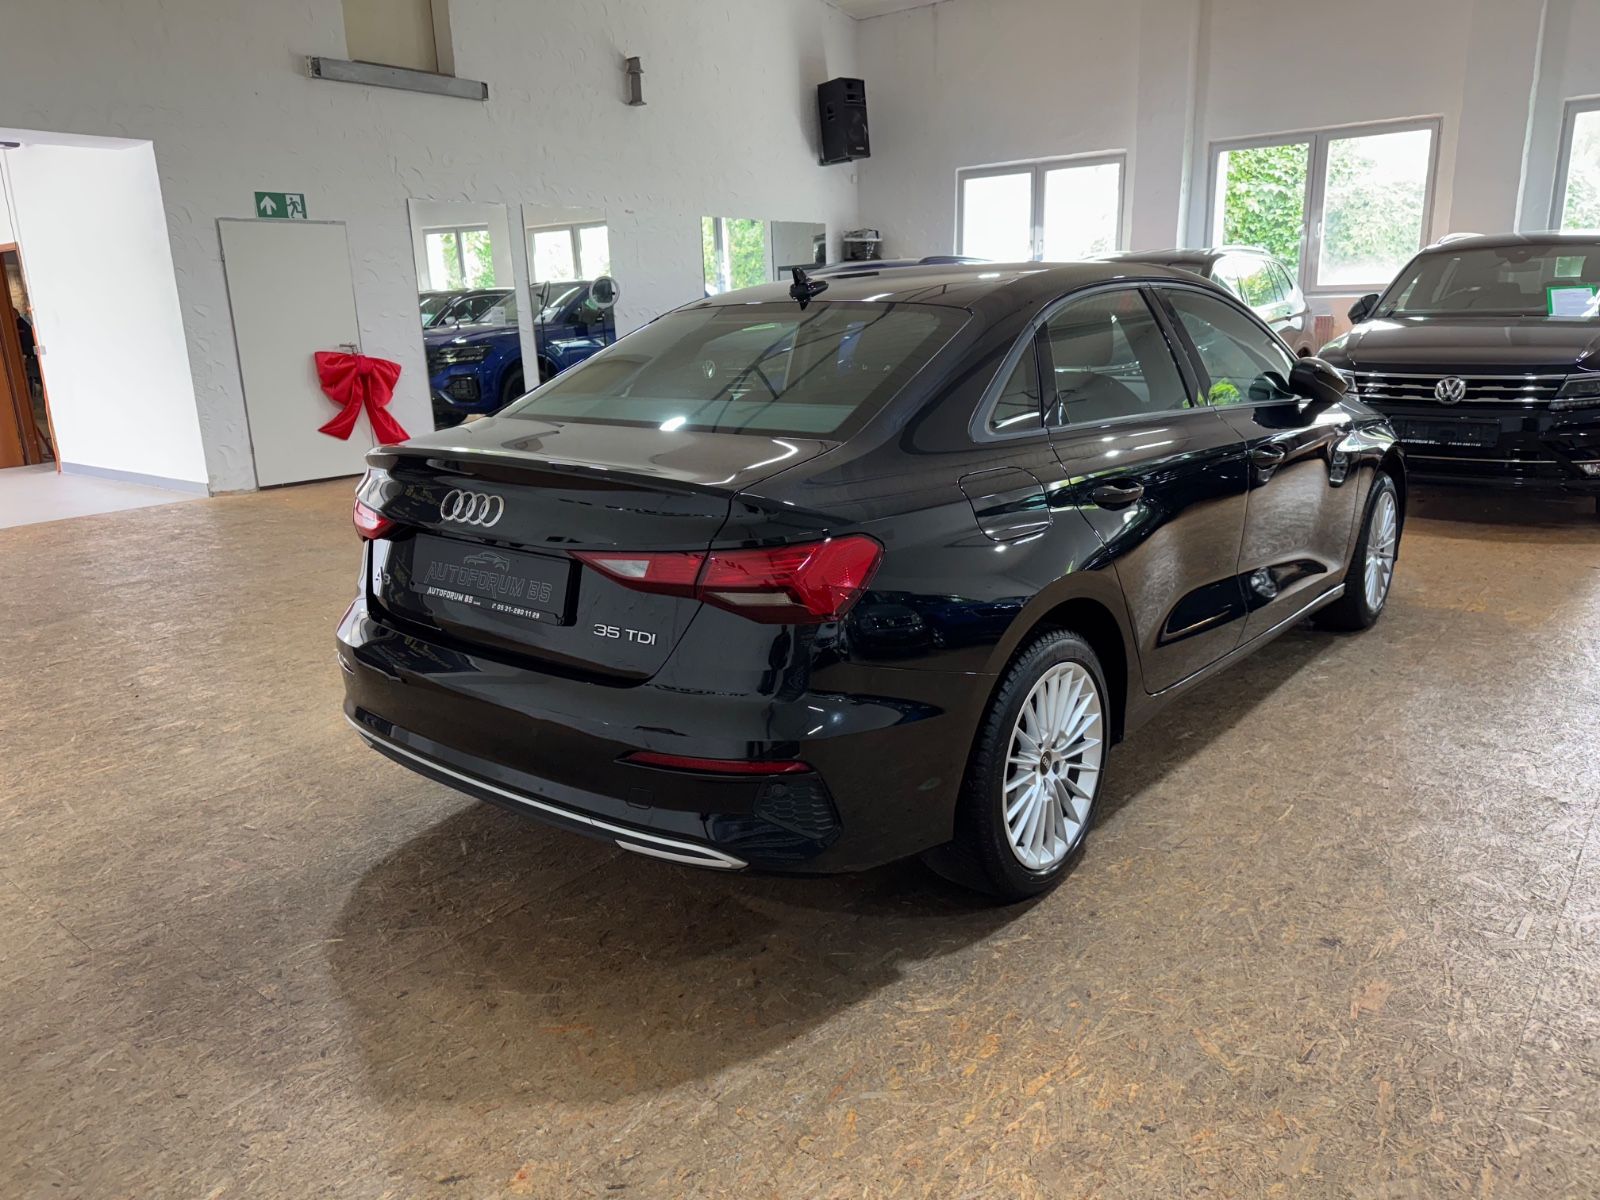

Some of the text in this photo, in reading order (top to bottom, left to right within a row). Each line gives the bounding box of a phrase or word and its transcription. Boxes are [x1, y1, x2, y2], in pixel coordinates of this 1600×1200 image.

[424, 561, 552, 602] AUTOFORUM BS
[427, 586, 474, 604] AUTOFORUM BS
[593, 623, 656, 645] 35 TDI
